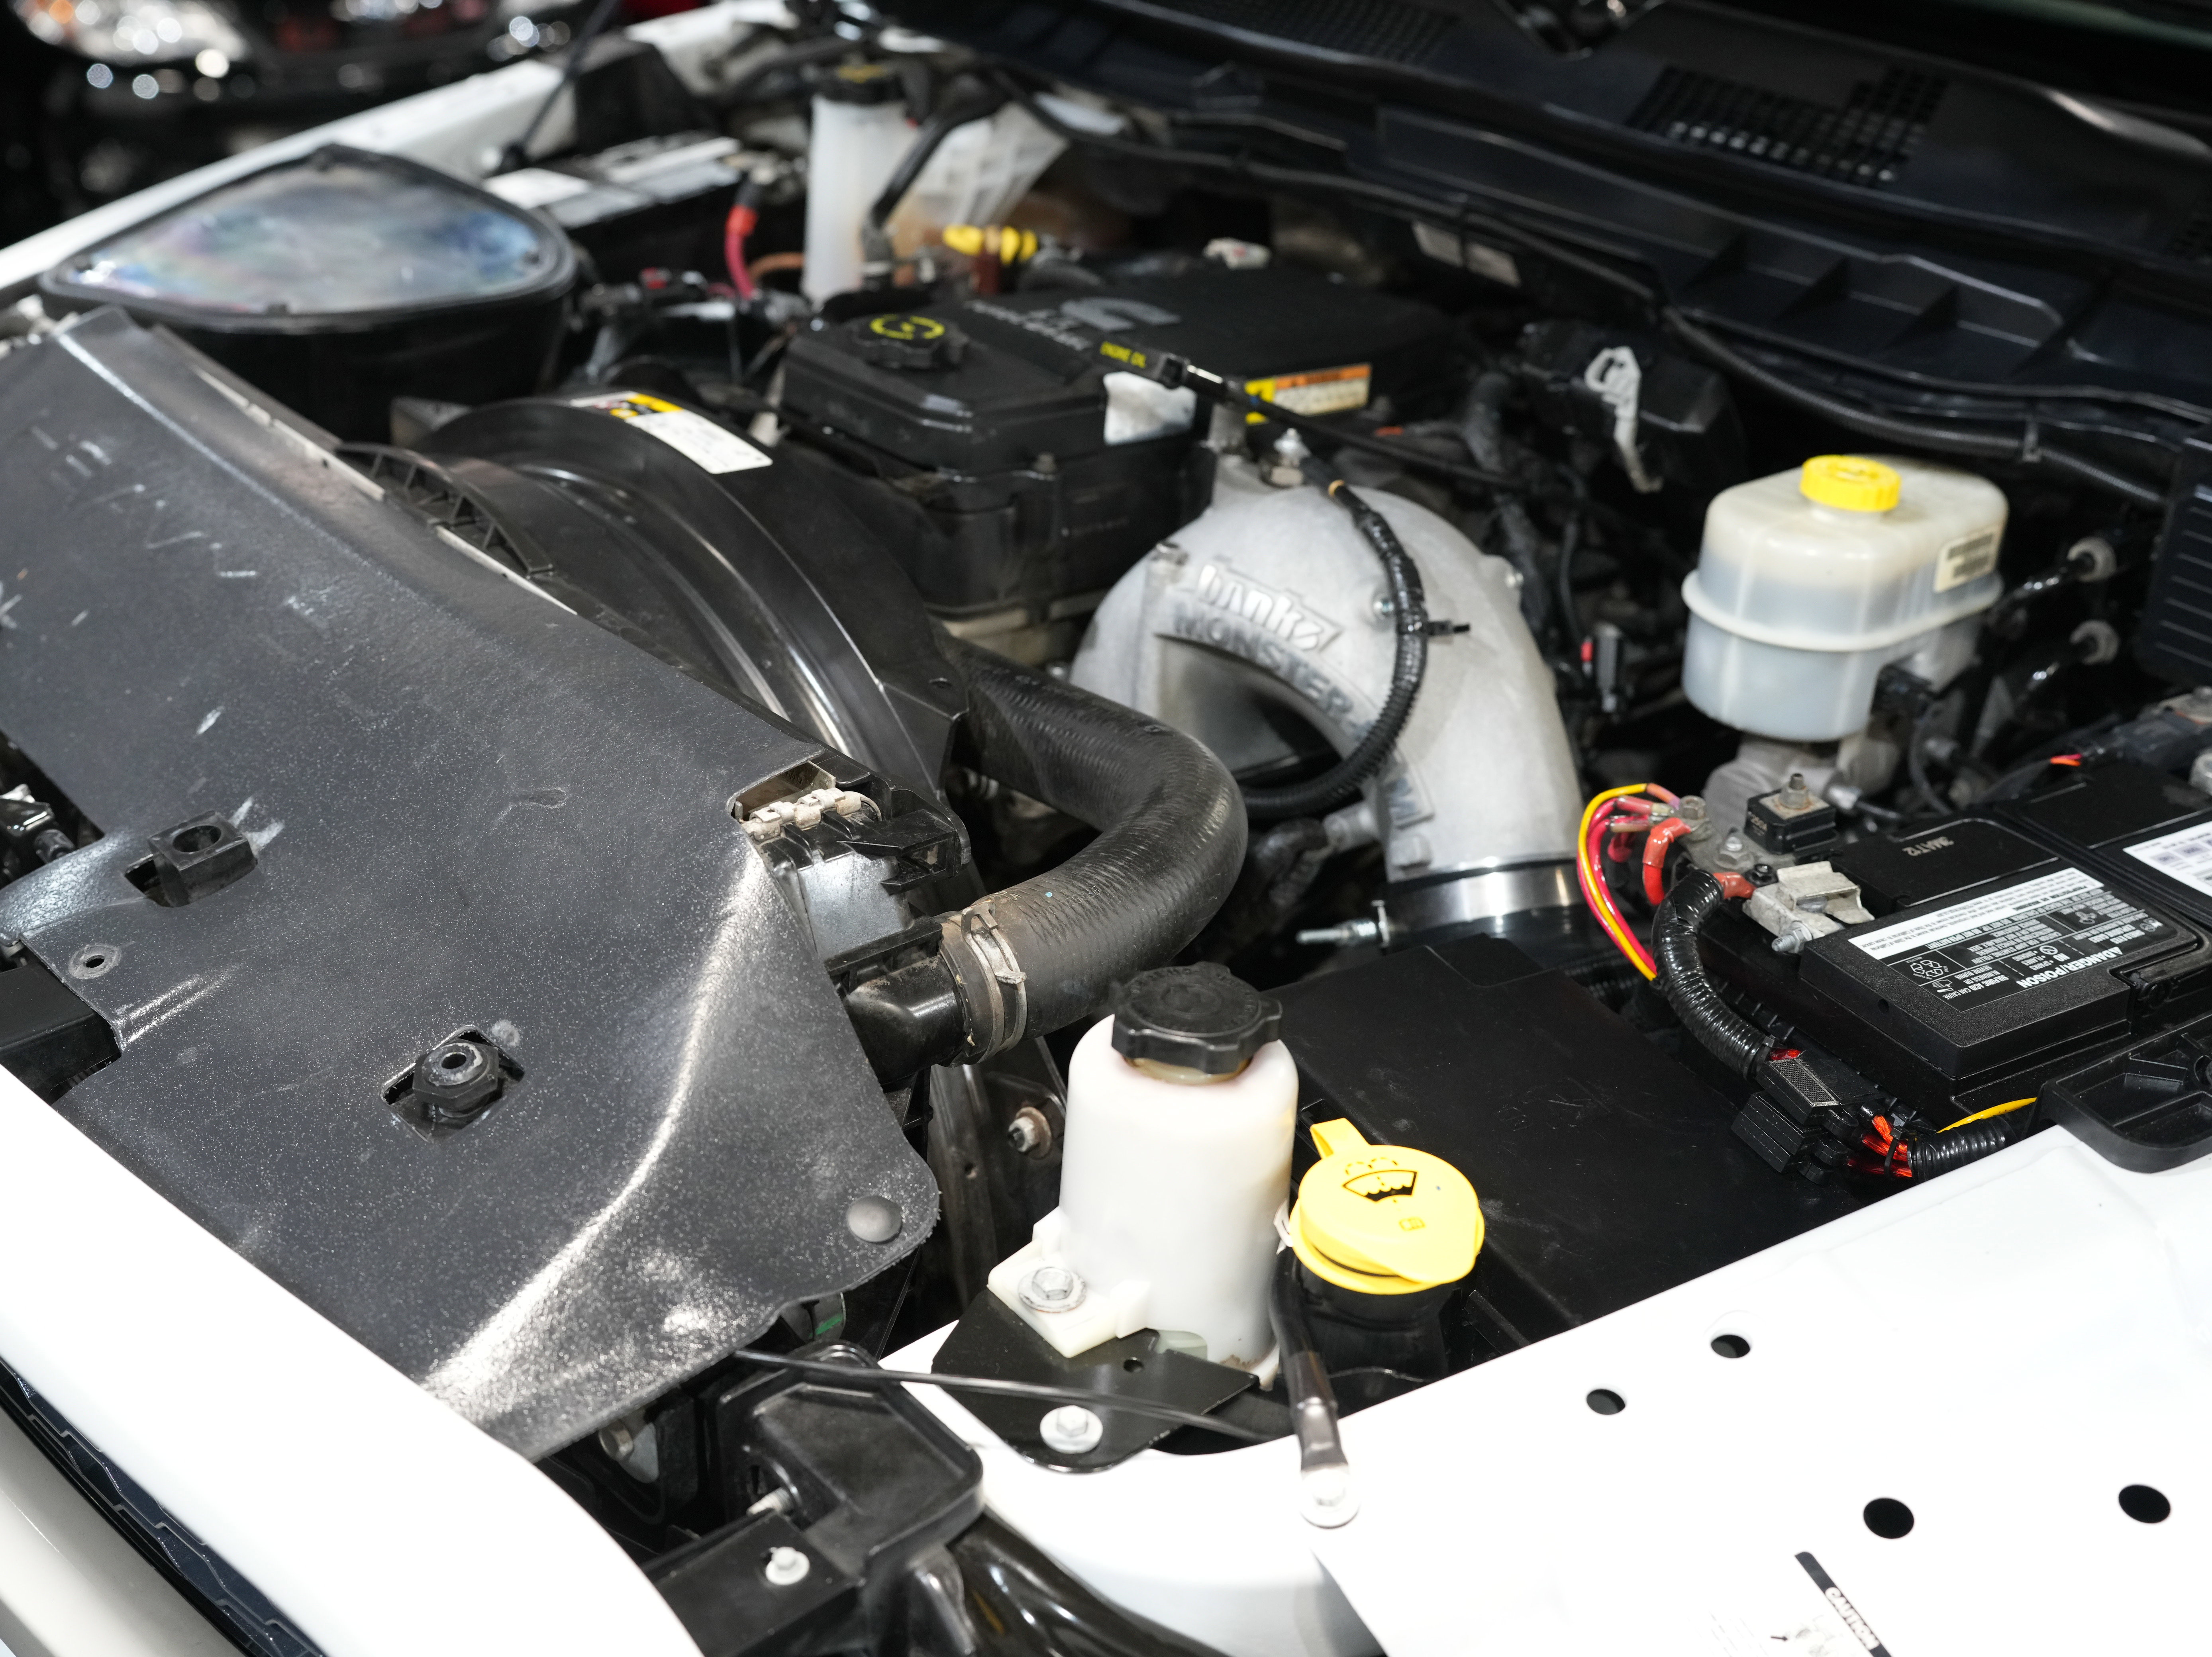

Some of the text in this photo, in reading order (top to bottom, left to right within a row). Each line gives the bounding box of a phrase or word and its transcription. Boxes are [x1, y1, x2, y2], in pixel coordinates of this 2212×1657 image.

[2010, 951, 2037, 961] SMOKING
[2020, 956, 2045, 966] FLAMES
[2051, 953, 2071, 962] NO
[2014, 950, 2118, 987] DANGER/POISON
[2028, 960, 2053, 970] SPARKS
[1953, 965, 1993, 979] SEVERE BURNS
[1970, 970, 2001, 981] BLINDNESS
[1980, 975, 2010, 986] SULFURIC
[1941, 991, 1962, 999] CAUSE
[1825, 1587, 1880, 1650] CAUTION
